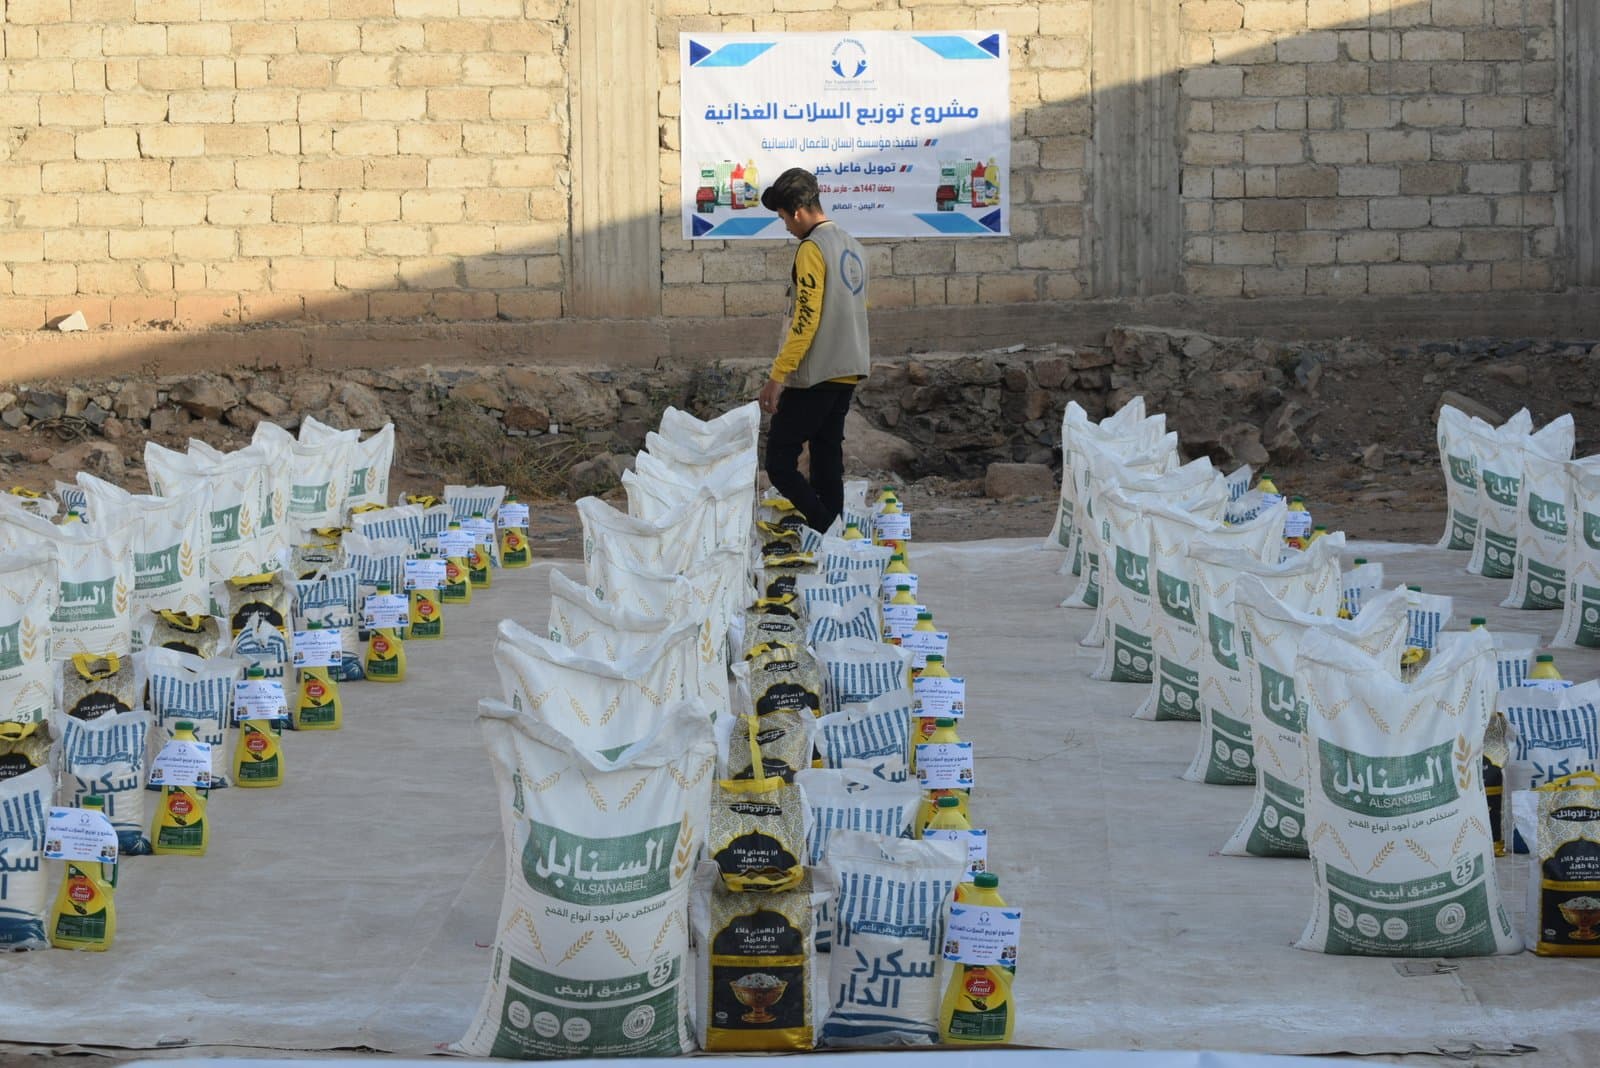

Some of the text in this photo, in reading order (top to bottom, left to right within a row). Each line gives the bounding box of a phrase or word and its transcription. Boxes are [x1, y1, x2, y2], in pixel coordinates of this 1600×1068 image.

[704, 99, 978, 125] مشروع توزيع السلات الغذائية
[856, 137, 891, 151] مؤسسة
[814, 162, 896, 175] تمويل فاعل خير
[1333, 754, 1444, 804] السنابل
[1369, 790, 1436, 808] ALSANABEL
[1412, 820, 1424, 829] من
[535, 836, 664, 889] السنابل
[1456, 860, 1471, 880] 25
[572, 879, 648, 896] ALSANABEL
[1369, 881, 1447, 899] دقيق أبيض
[593, 911, 614, 924] أجود
[616, 912, 630, 922] من
[632, 900, 667, 918] مستخلص
[653, 959, 670, 980] 25
[867, 948, 936, 983] سكر
[554, 982, 641, 998] دقيق أبيض
[836, 973, 901, 1009] الدار
